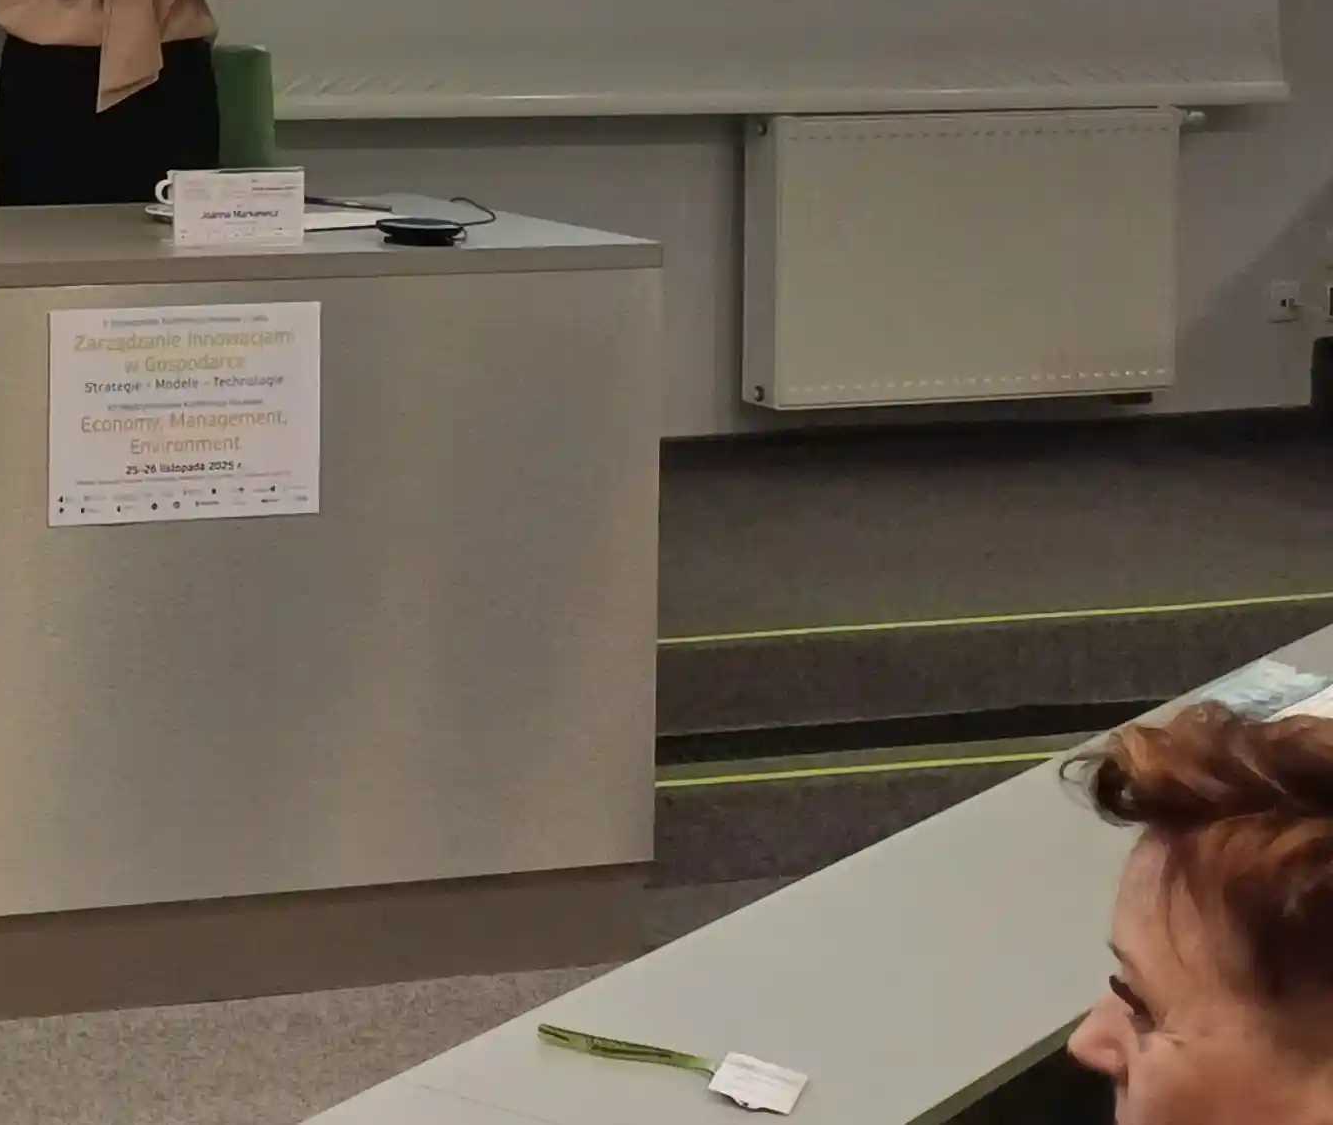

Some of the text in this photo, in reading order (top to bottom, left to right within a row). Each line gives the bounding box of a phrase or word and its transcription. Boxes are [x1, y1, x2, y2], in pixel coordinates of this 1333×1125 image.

[85, 374, 283, 394] Strategie Modele Technologie
[130, 435, 240, 456] Environment
